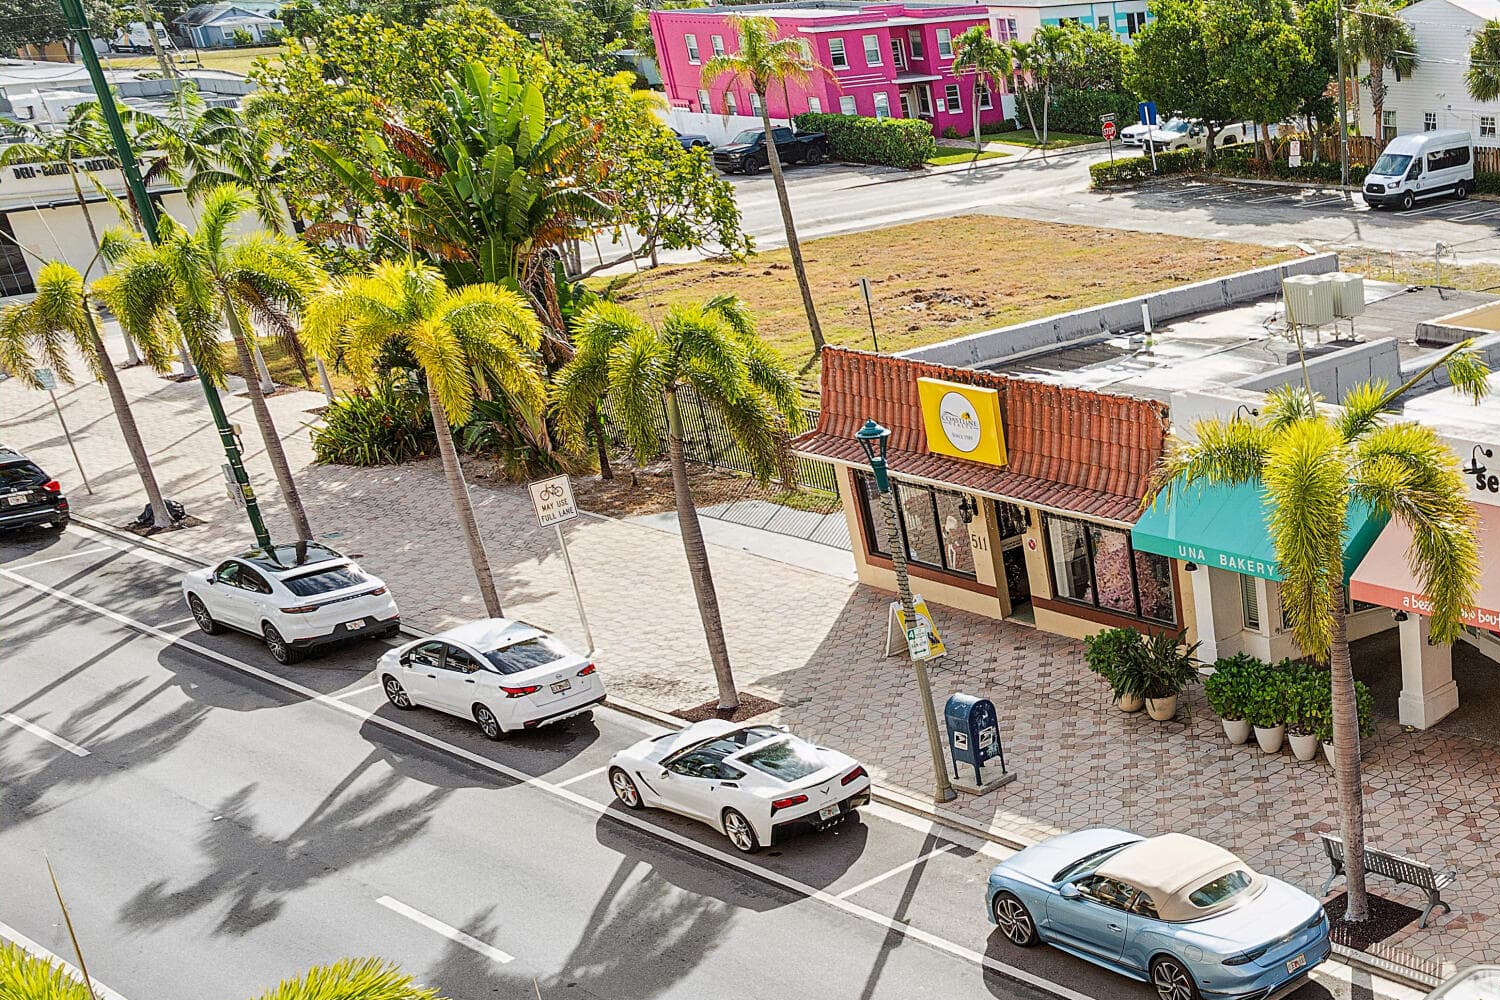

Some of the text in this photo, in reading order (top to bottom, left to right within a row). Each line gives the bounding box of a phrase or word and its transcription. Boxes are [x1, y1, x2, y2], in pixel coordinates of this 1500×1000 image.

[13, 166, 36, 179] DELI
[541, 498, 569, 511] MAY USE
[541, 507, 574, 523] FULL LANE
[971, 533, 988, 551] 511
[1178, 545, 1275, 576] UNA BAKERY
[1402, 596, 1409, 607] a
